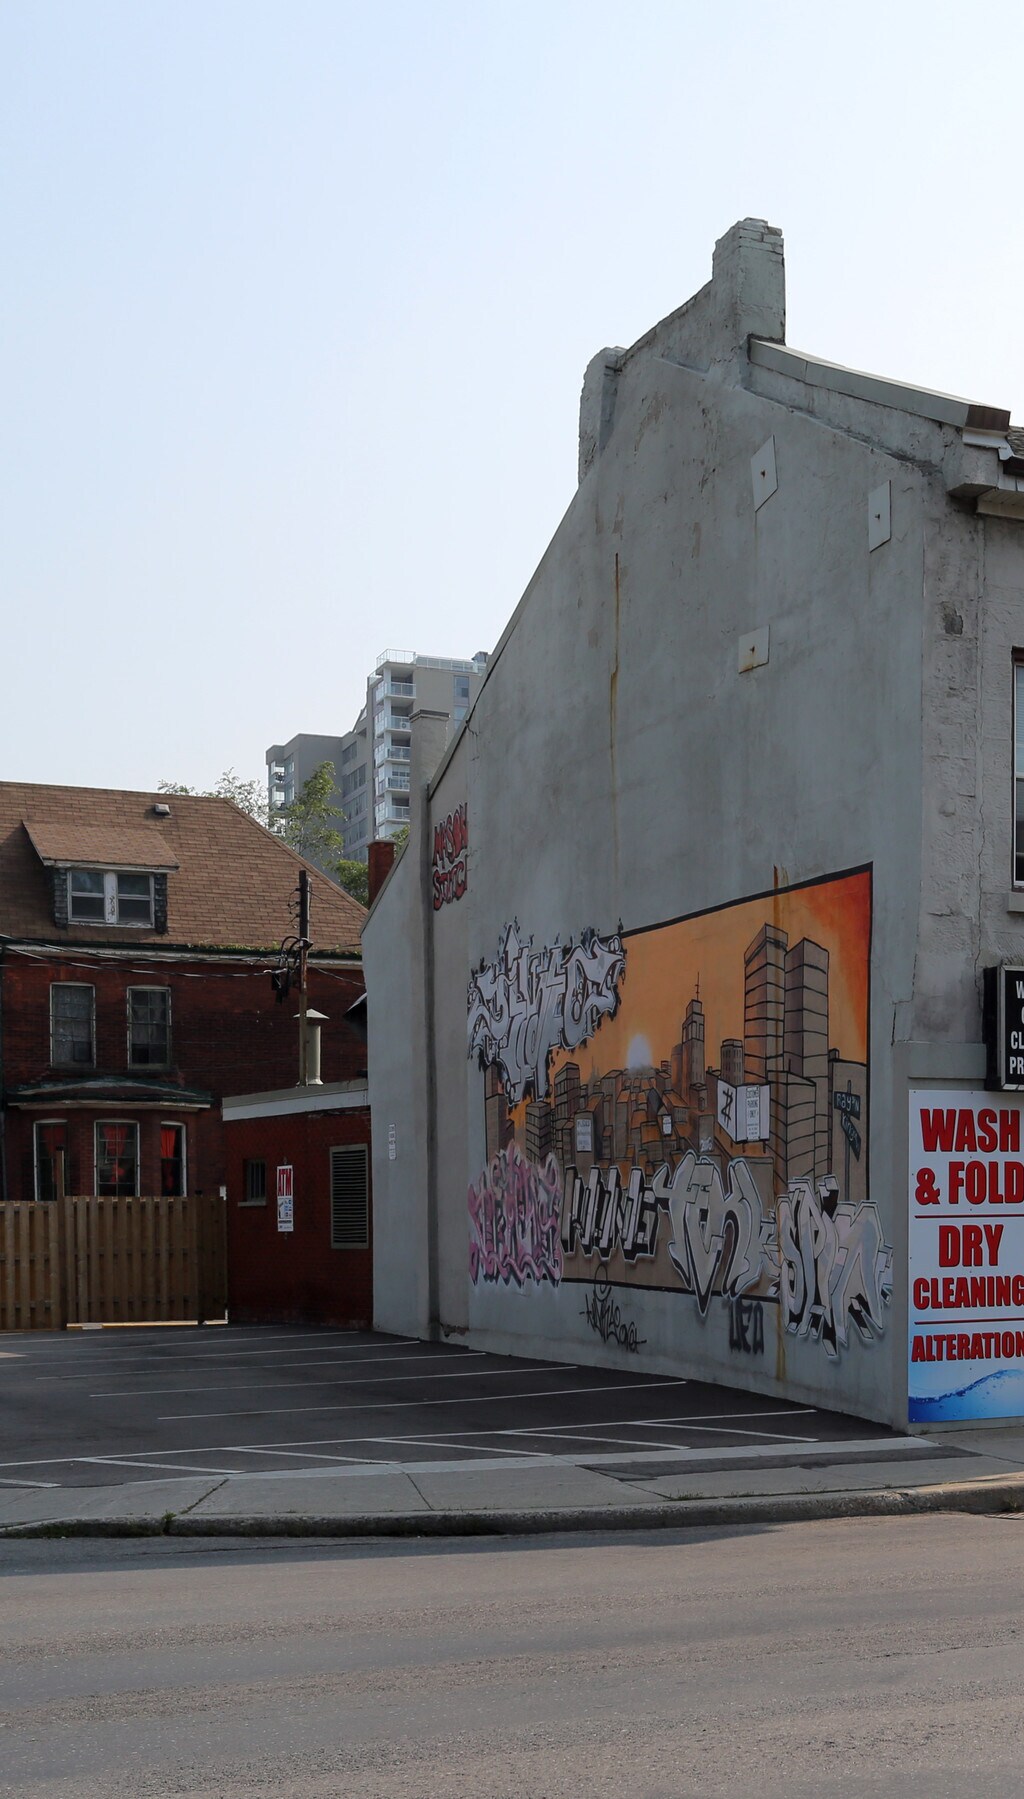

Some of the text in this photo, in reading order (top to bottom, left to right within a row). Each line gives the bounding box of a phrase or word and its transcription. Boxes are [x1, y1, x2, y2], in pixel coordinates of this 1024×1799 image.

[919, 1108, 1021, 1153] WASH
[278, 1168, 292, 1197] ATM
[914, 1167, 941, 1206] &
[938, 1224, 1005, 1269] DRY
